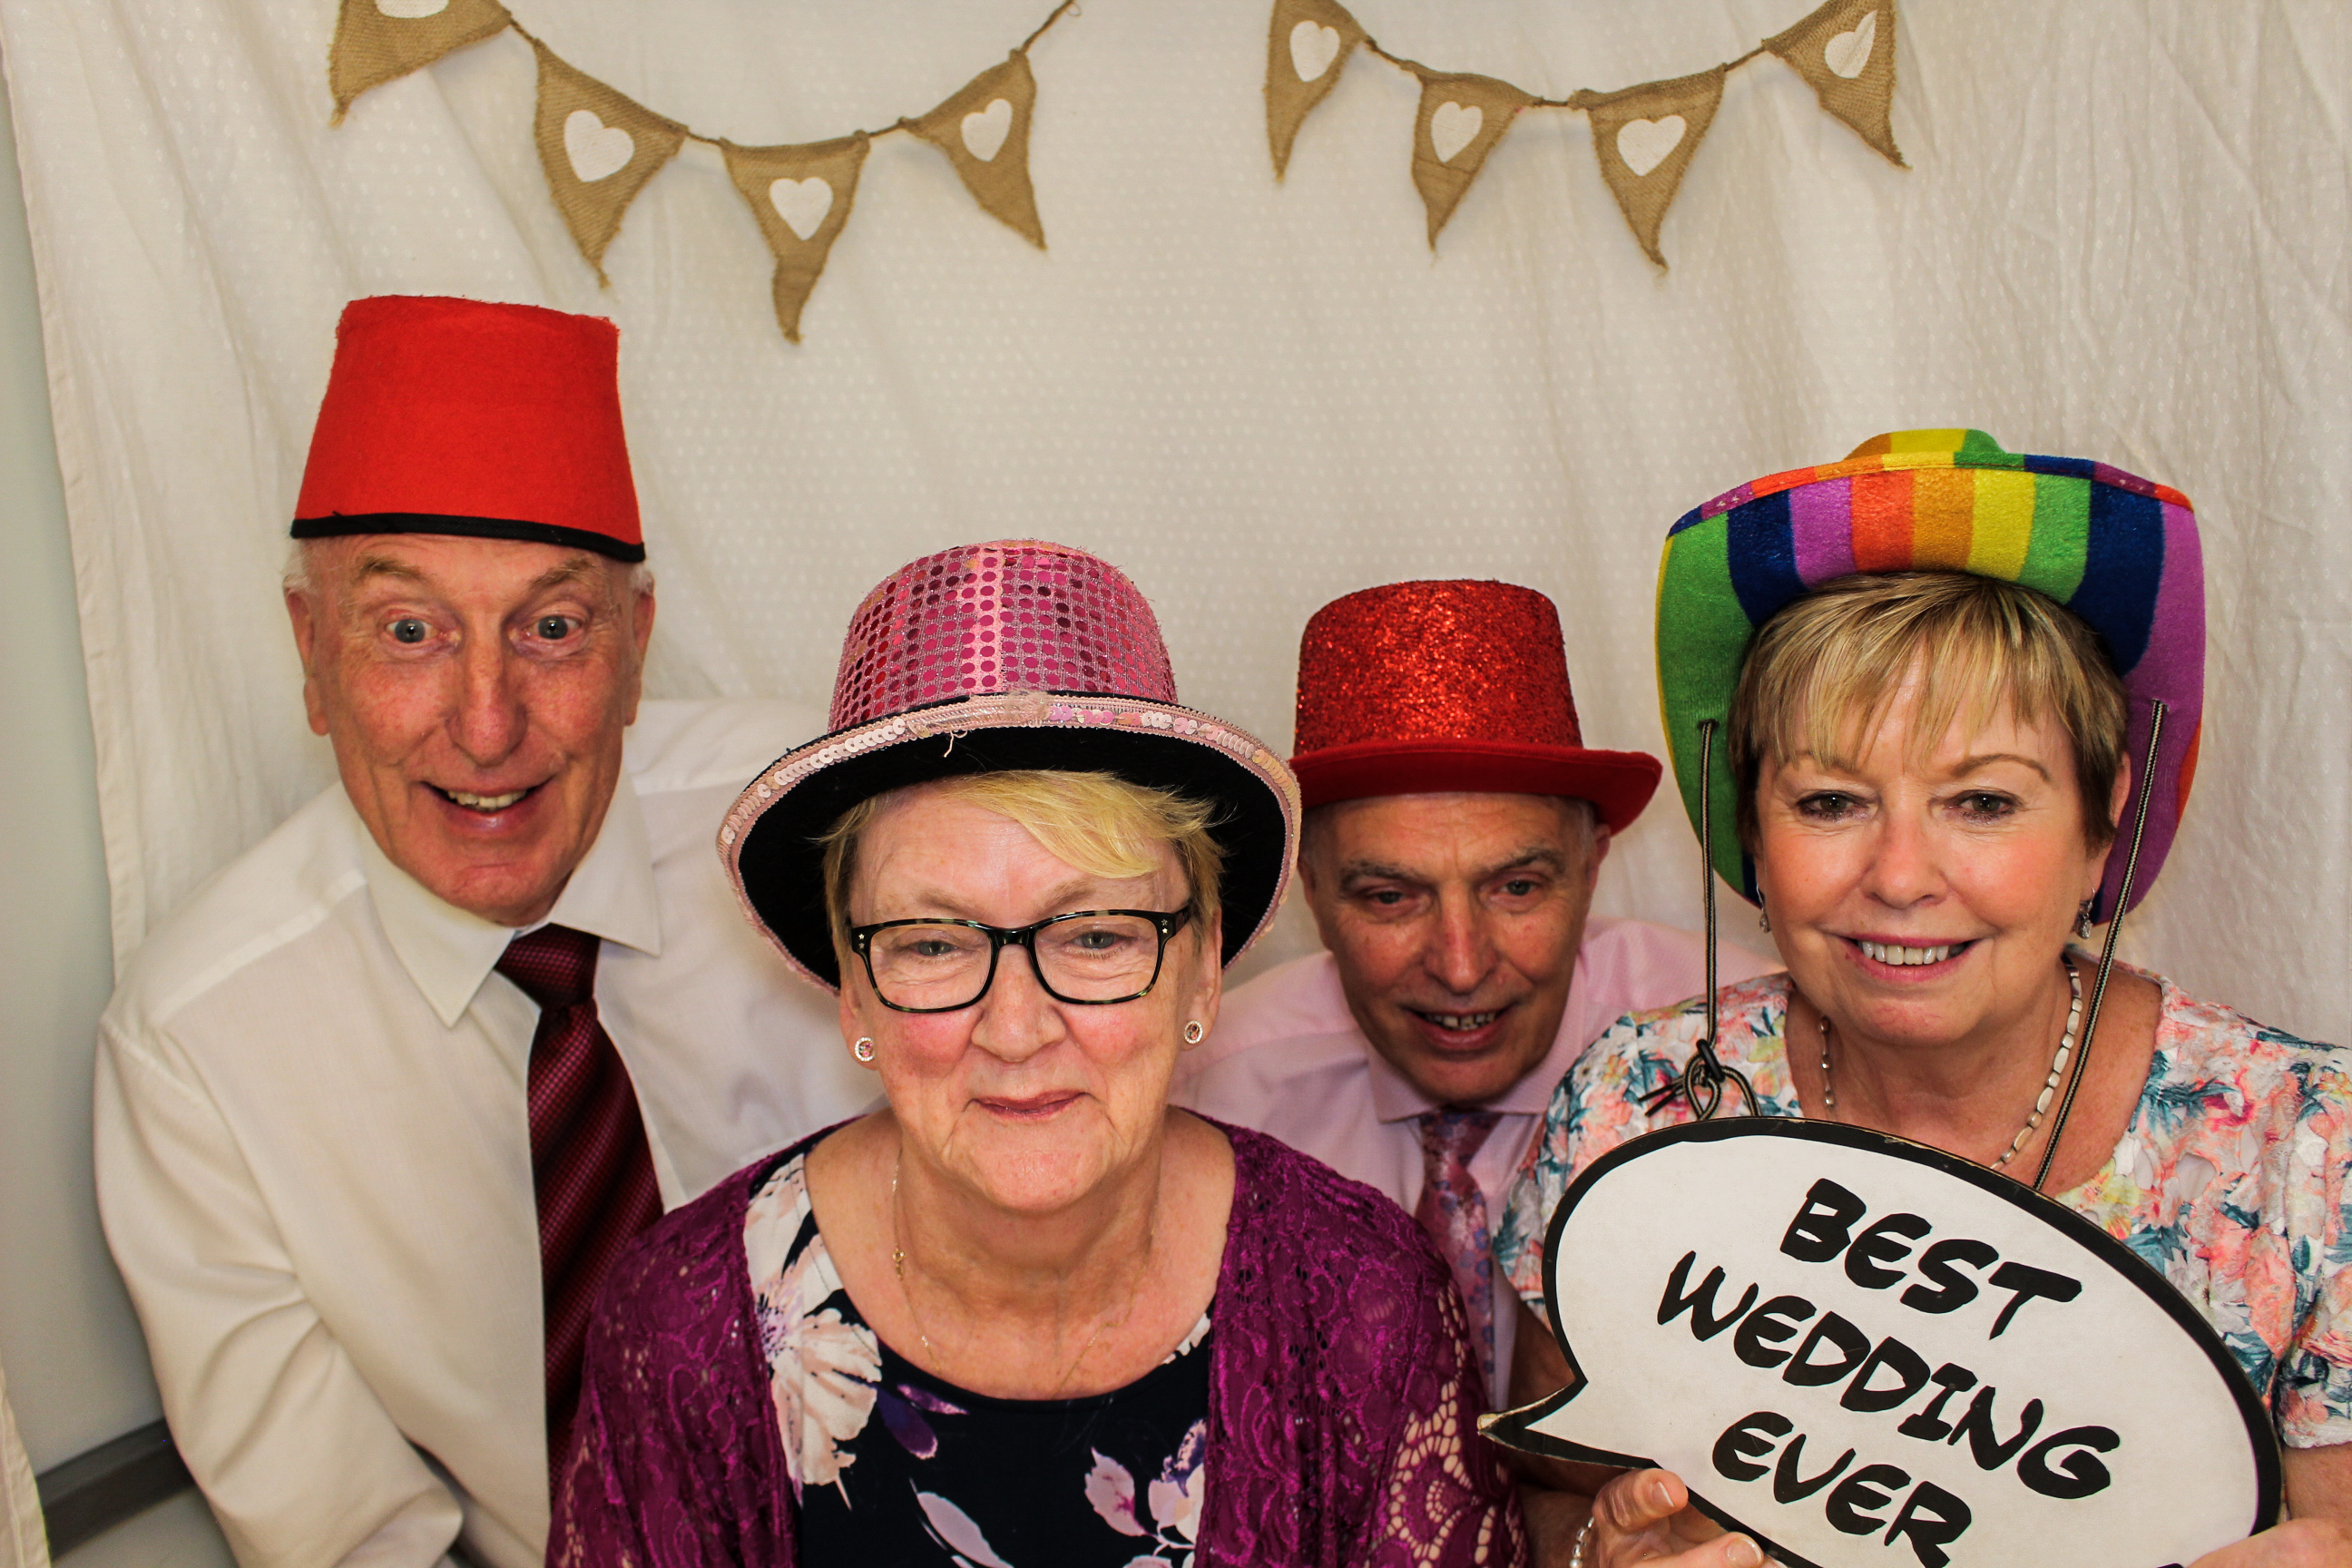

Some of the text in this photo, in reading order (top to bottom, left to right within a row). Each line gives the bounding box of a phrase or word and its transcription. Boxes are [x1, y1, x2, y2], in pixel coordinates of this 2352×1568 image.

[1780, 1179, 2082, 1339] BEST
[1657, 1250, 2121, 1499] WEDDING
[1711, 1412, 1972, 1568] EVER
